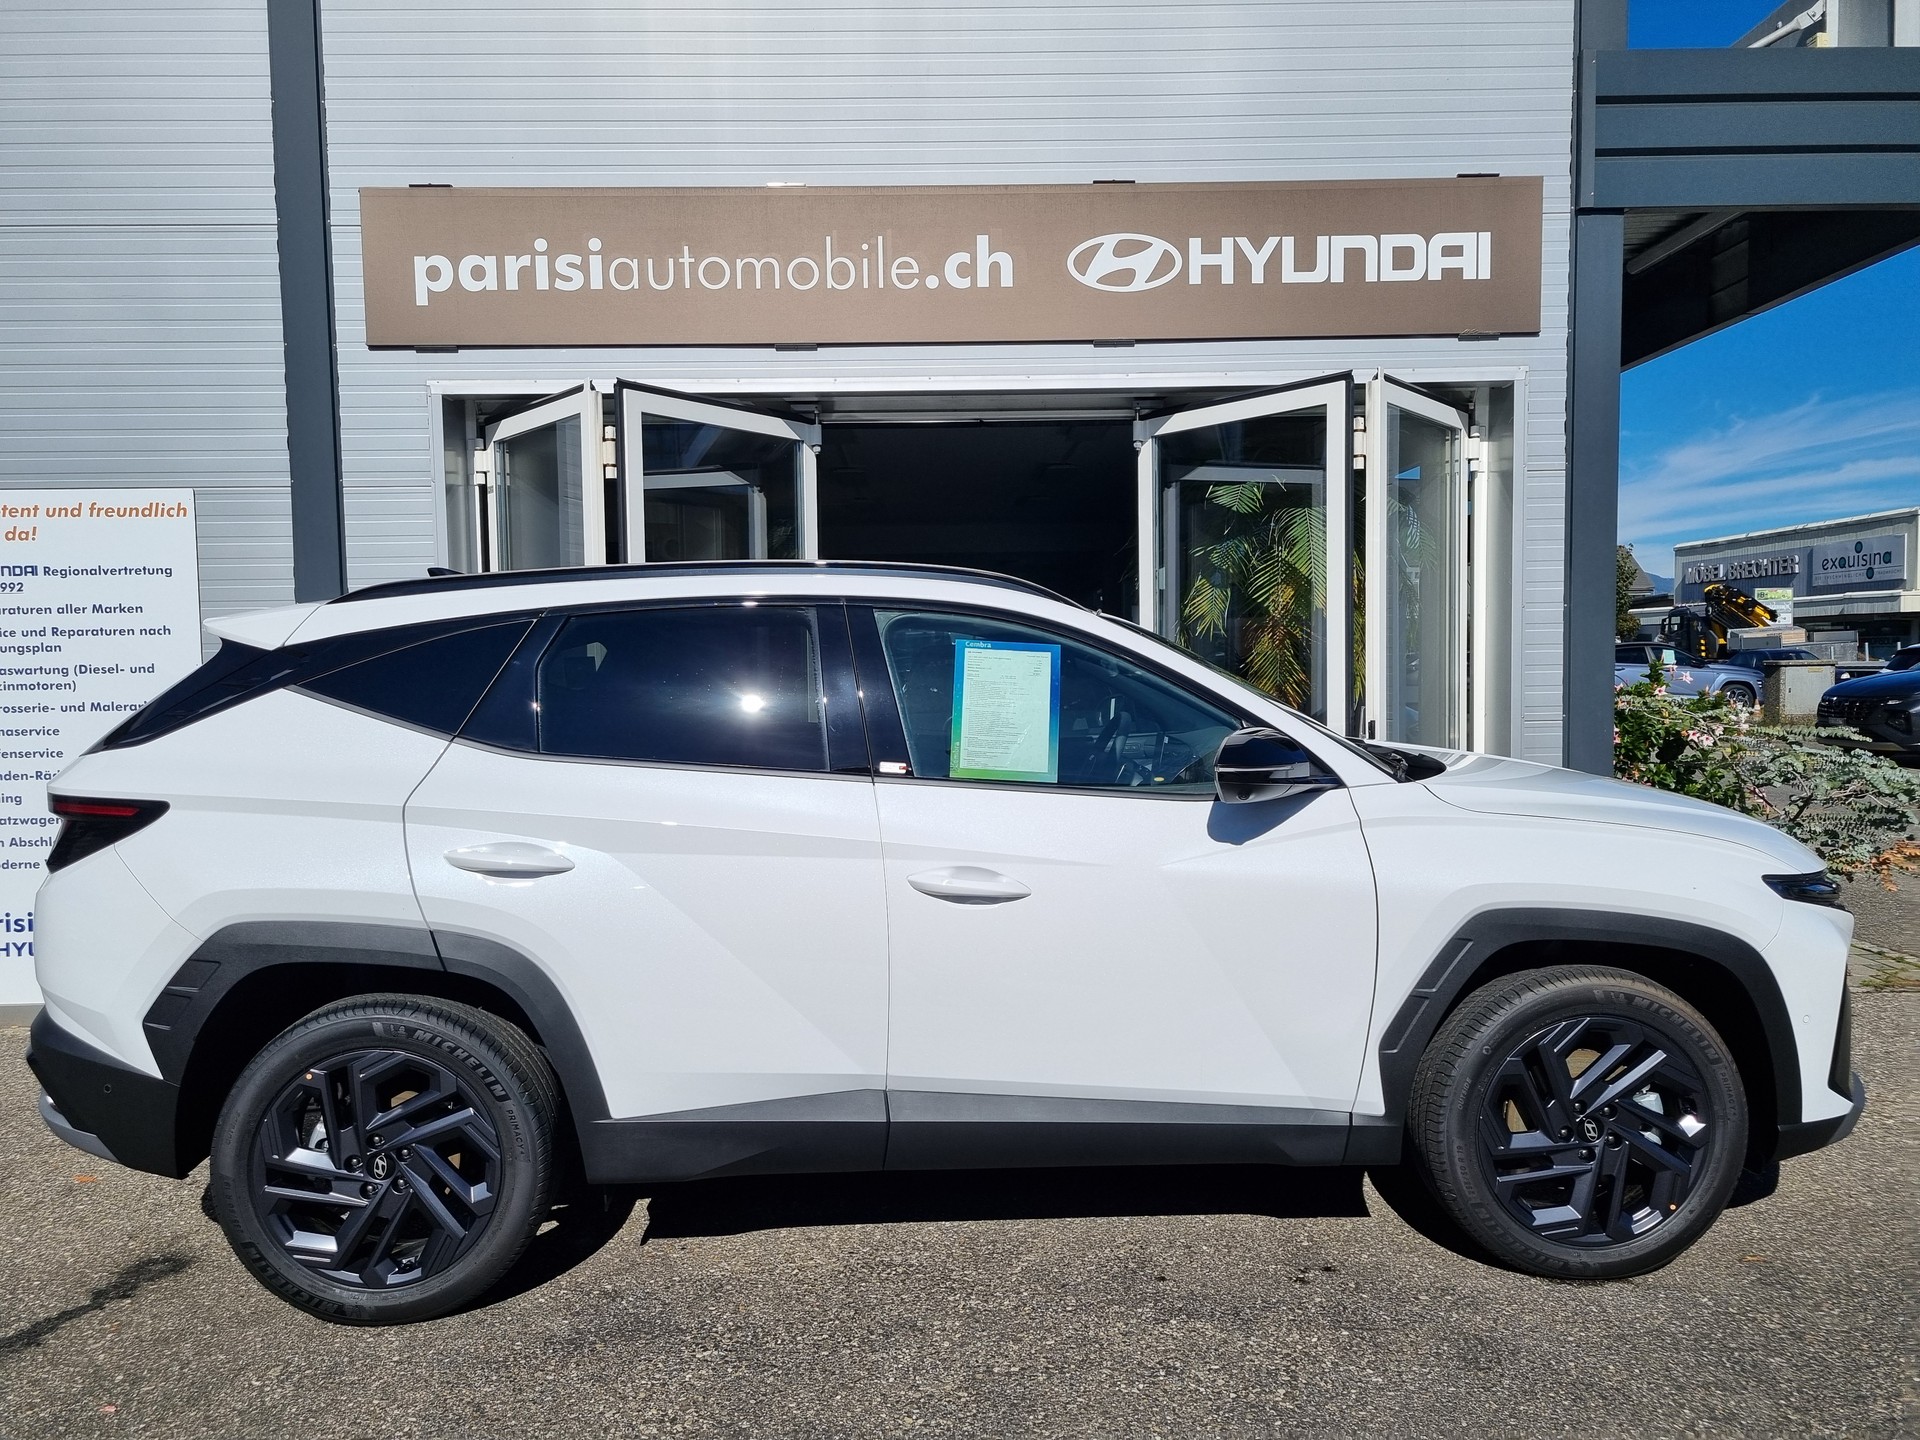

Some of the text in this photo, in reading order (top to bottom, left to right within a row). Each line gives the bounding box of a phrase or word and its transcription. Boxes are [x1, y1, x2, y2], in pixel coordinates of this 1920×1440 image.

[1188, 231, 1492, 285] HYUNDAI
[414, 234, 1014, 306] parisiautomobile.ch
[0, 502, 188, 518] tent und freundlich
[4, 526, 38, 542] da!
[1821, 542, 1893, 571] exquisina
[43, 565, 173, 578] Regionalvertretung
[1685, 562, 1727, 585] MÖBEL
[1728, 554, 1800, 581] BRECHTER
[0, 582, 24, 593] 992
[0, 603, 144, 615] raturen aller Marken
[21, 627, 47, 638] und
[51, 626, 135, 640] Reparaturen
[139, 625, 172, 636] nach
[0, 643, 62, 656] ungsplan
[0, 663, 155, 678] aswartung (Diesel- und
[0, 700, 147, 714] osserie- und Malerar
[0, 749, 64, 759] enservice
[9, 836, 56, 848] Abschl
[0, 859, 41, 870] derne
[1631, 995, 1720, 1061] MICHELIN
[413, 1029, 506, 1098] MICHELIN
[1719, 1072, 1737, 1112] PRIMACY
[505, 1109, 525, 1150] PRIMACY
